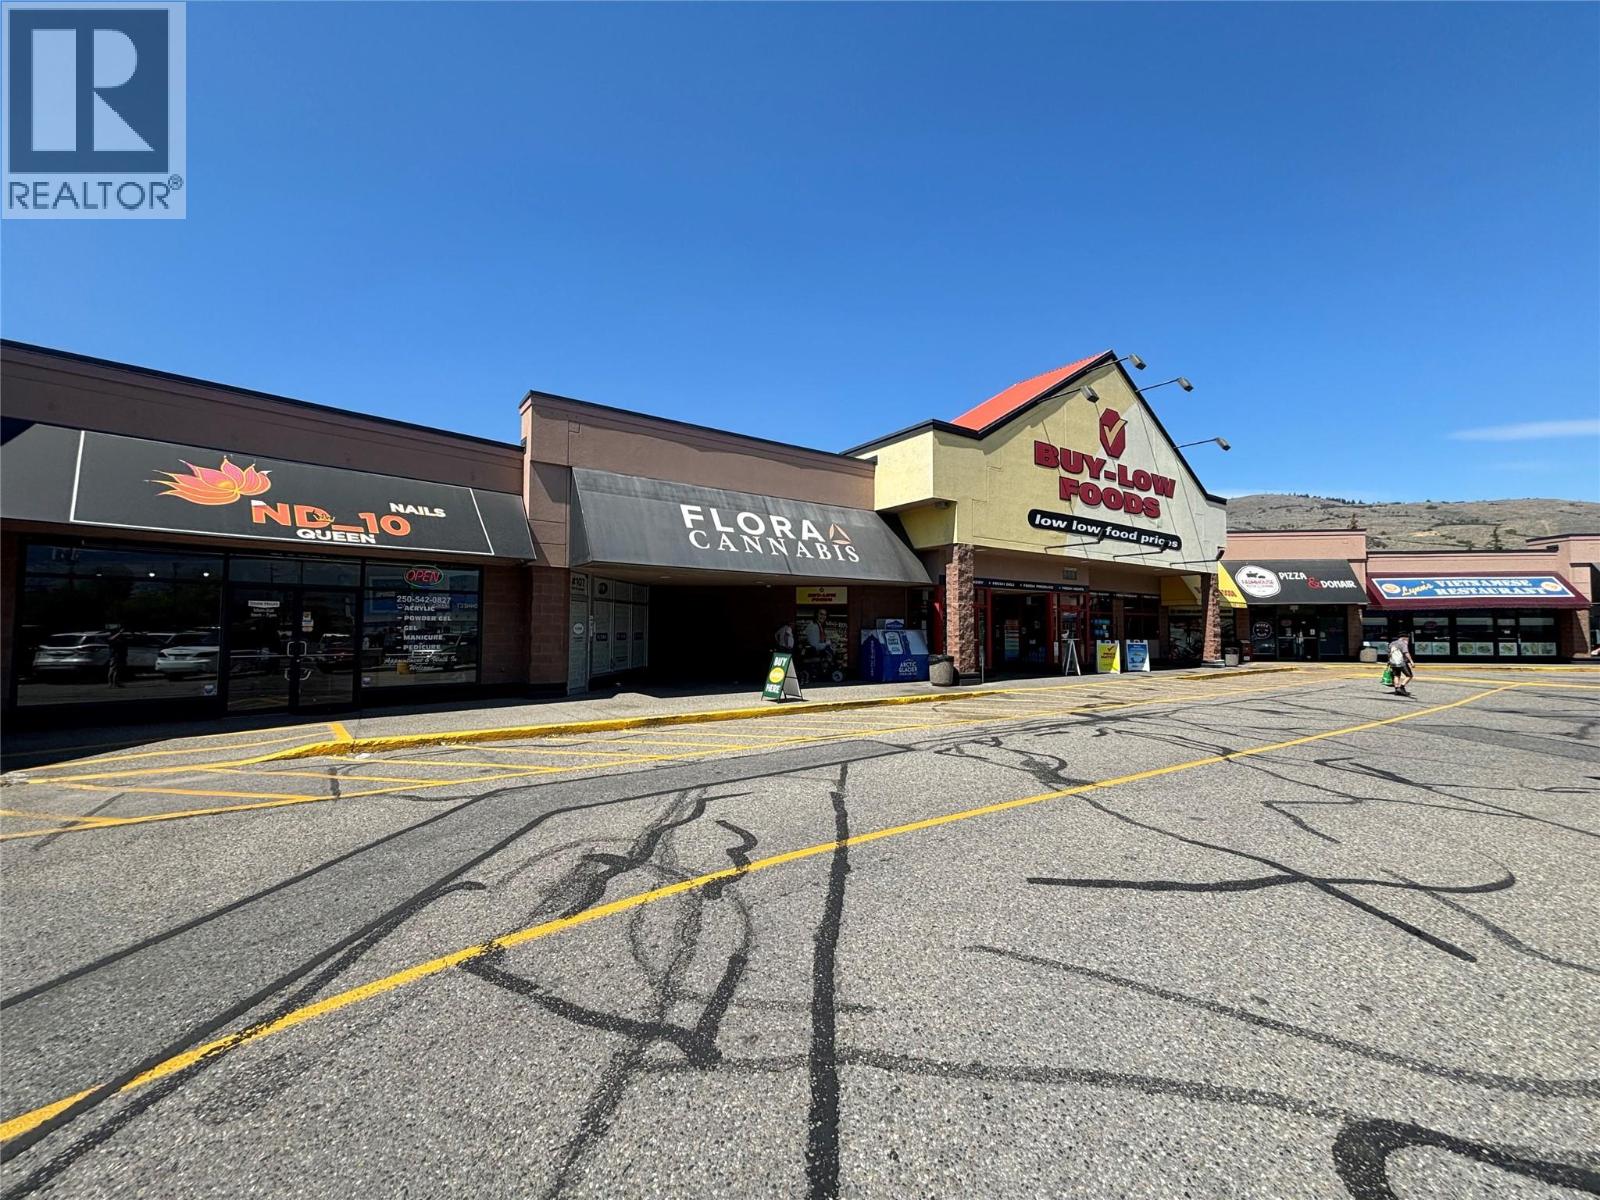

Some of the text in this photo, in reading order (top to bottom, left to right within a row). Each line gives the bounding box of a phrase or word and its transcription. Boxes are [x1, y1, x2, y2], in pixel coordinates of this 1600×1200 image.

[1034, 440, 1176, 499] BUY-LOW
[1059, 476, 1161, 519] FOODS
[389, 502, 446, 517] NAILS
[680, 504, 826, 543] FLORA
[296, 528, 376, 544] QUEEN
[1034, 514, 1179, 549] low low food prics
[688, 530, 860, 563] CANNABIS
[405, 570, 440, 583] OPEN
[1278, 571, 1358, 590] PIZZA & DONAIR
[1434, 579, 1532, 588] VIETNAMESE
[1434, 587, 1547, 596] RESTAURANT
[396, 595, 452, 605] 250-542-0827
[404, 604, 436, 612] ACRYLIC
[773, 656, 787, 667] BUY
[765, 683, 781, 693] HERE
